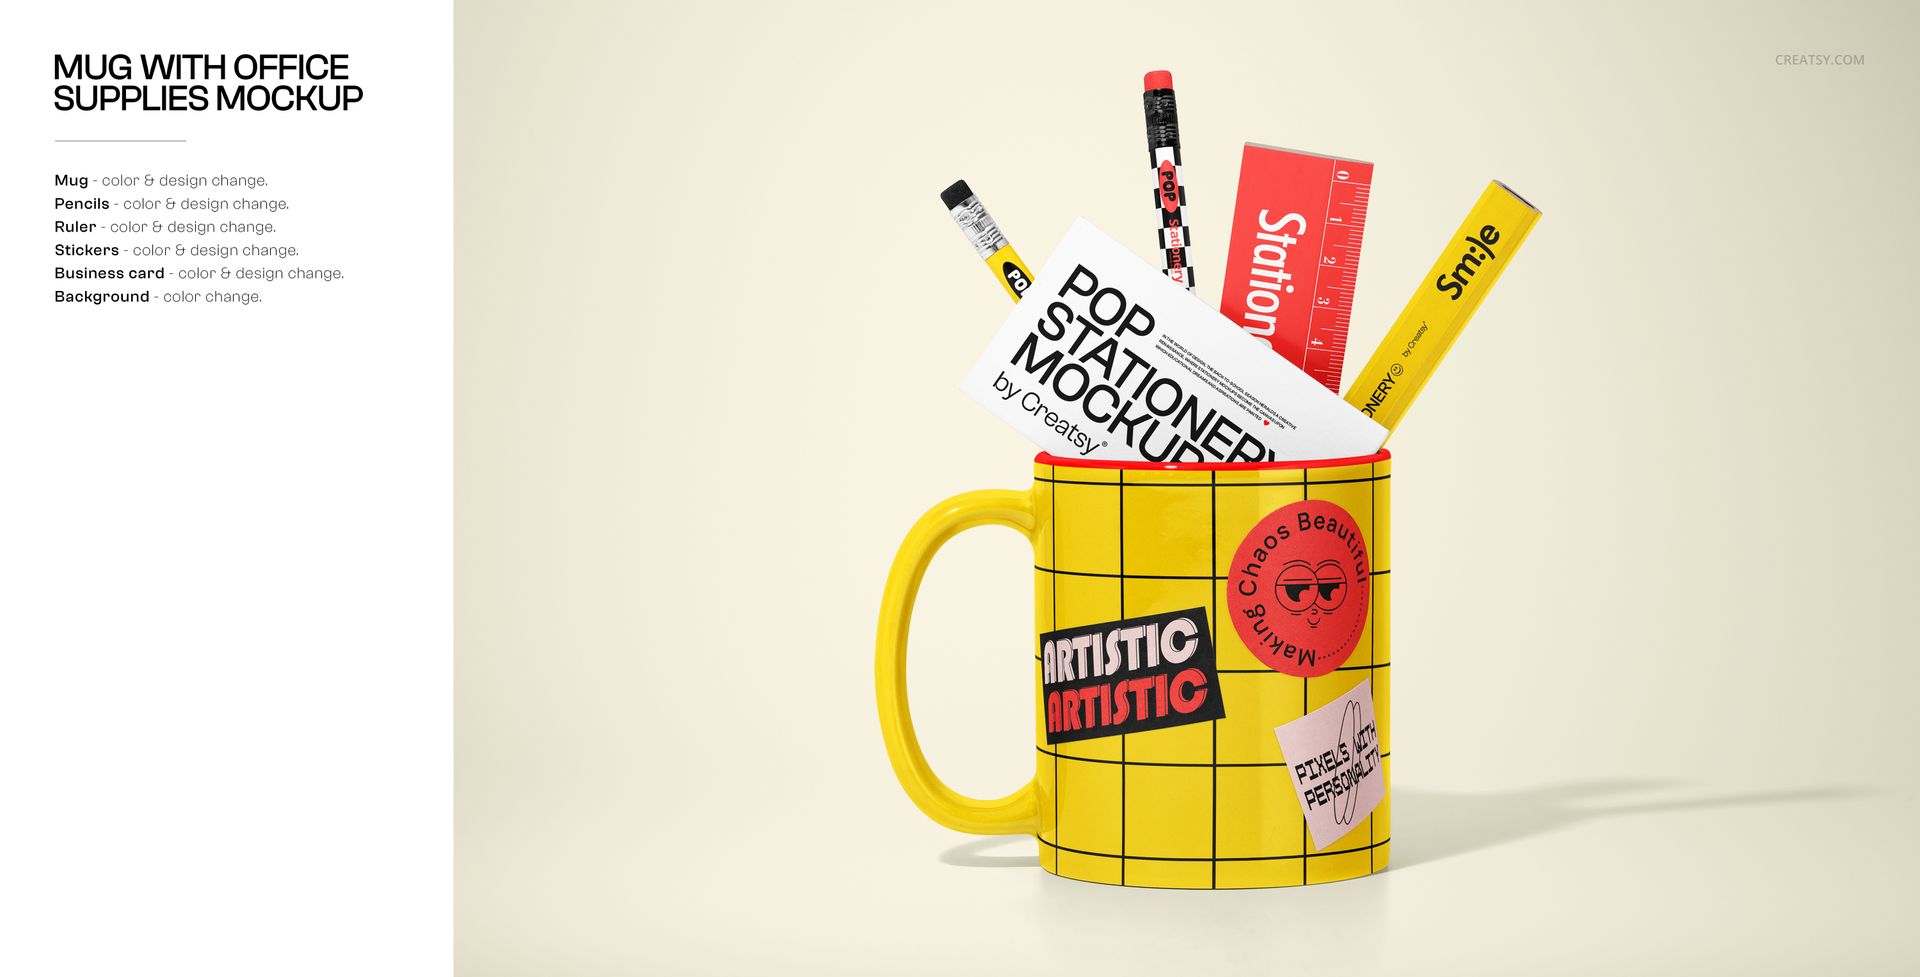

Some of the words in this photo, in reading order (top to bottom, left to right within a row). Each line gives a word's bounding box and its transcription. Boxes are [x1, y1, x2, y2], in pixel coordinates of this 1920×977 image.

[1161, 171, 1176, 202] POP
[1336, 170, 1350, 180] 0
[1008, 269, 1028, 296] PO
[1168, 219, 1183, 283] Stationery
[1243, 209, 1306, 350] Station
[1323, 256, 1336, 264] 2
[1057, 264, 1155, 338] POP
[1317, 296, 1330, 305] 3
[1167, 353, 1192, 372] EDUCATIONAL
[1402, 347, 1412, 357] by
[993, 371, 1022, 400] by
[1173, 342, 1187, 353] WORLD
[1278, 415, 1296, 430] CREATIVE
[1197, 366, 1220, 383] STATIONERY
[1236, 393, 1252, 406] BECOME
[1239, 525, 1290, 596] Chaos
[1297, 512, 1367, 582] Beautiful
[1043, 617, 1198, 684] ARTISTIC
[1243, 604, 1315, 667] Making
[1048, 667, 1208, 733] ARTISTIC
[1295, 742, 1350, 784] PIXELS
[1353, 720, 1377, 753] WITH
[1304, 744, 1380, 810] PERSONALITY
